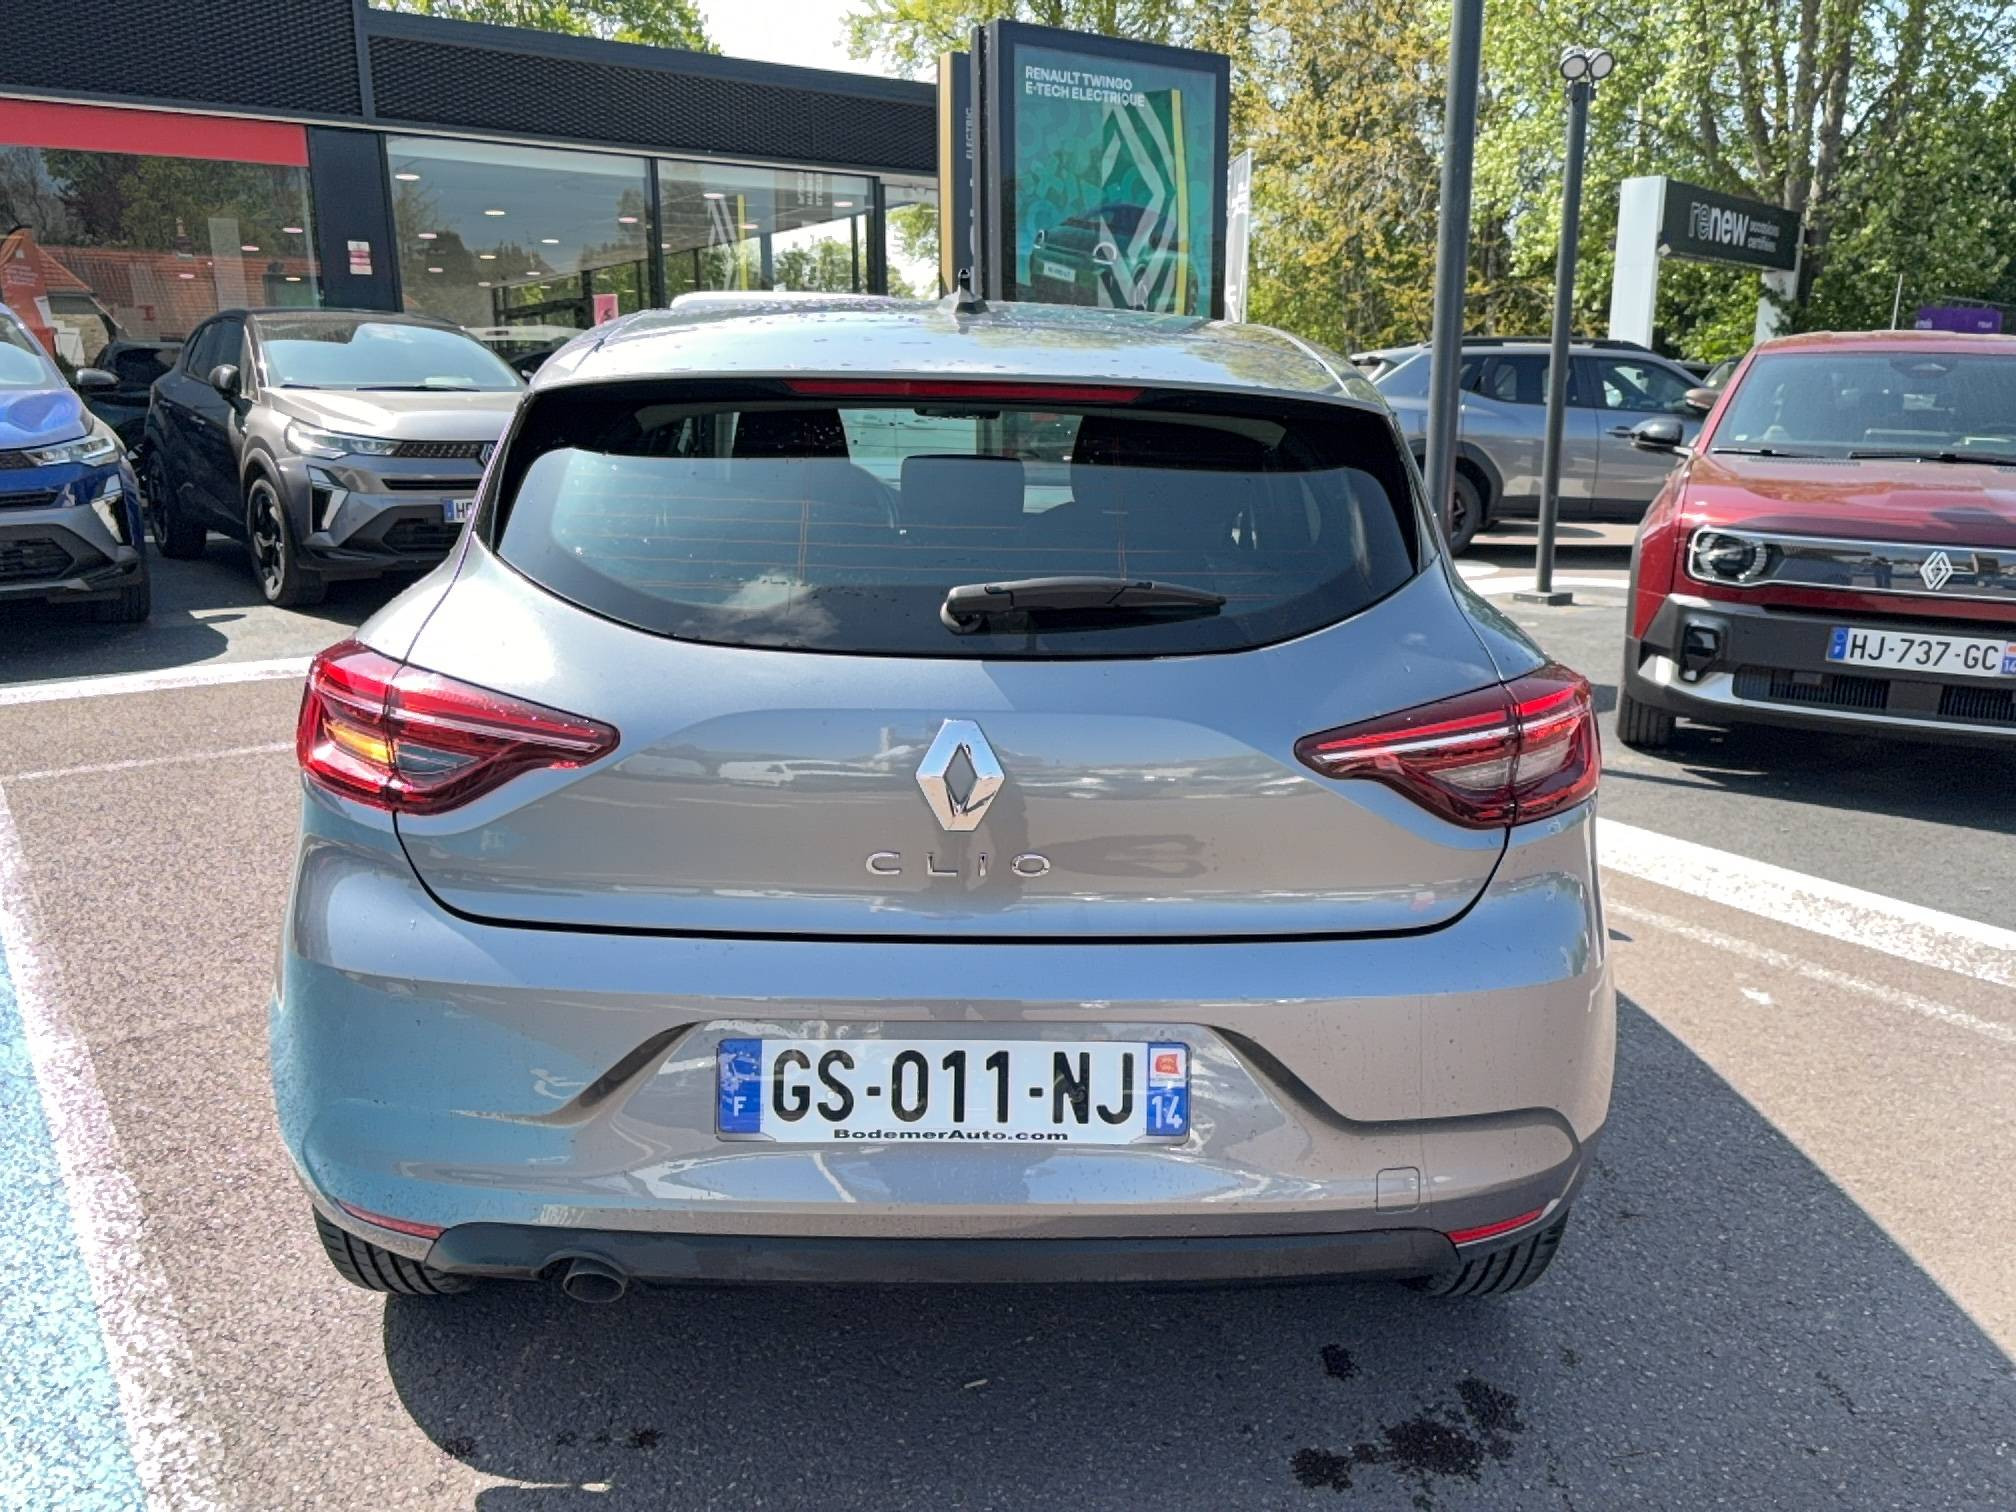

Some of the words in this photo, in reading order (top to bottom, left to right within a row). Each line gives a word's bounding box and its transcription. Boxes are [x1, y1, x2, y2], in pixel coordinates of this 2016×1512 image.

[1025, 65, 1080, 85] RENAULT
[1082, 73, 1133, 91] TWINGO
[1025, 81, 1069, 99] E-TECH
[1071, 86, 1145, 107] ELECTRIQUE
[1688, 201, 1750, 247] renew
[1849, 633, 1999, 671] HJ-737-GC
[865, 852, 1051, 878] CLIO
[733, 1096, 747, 1117] F
[772, 1049, 1135, 1125] GS-011-NJ
[1151, 1095, 1183, 1129] 14
[833, 1128, 1069, 1141] BodemerAuto.com
